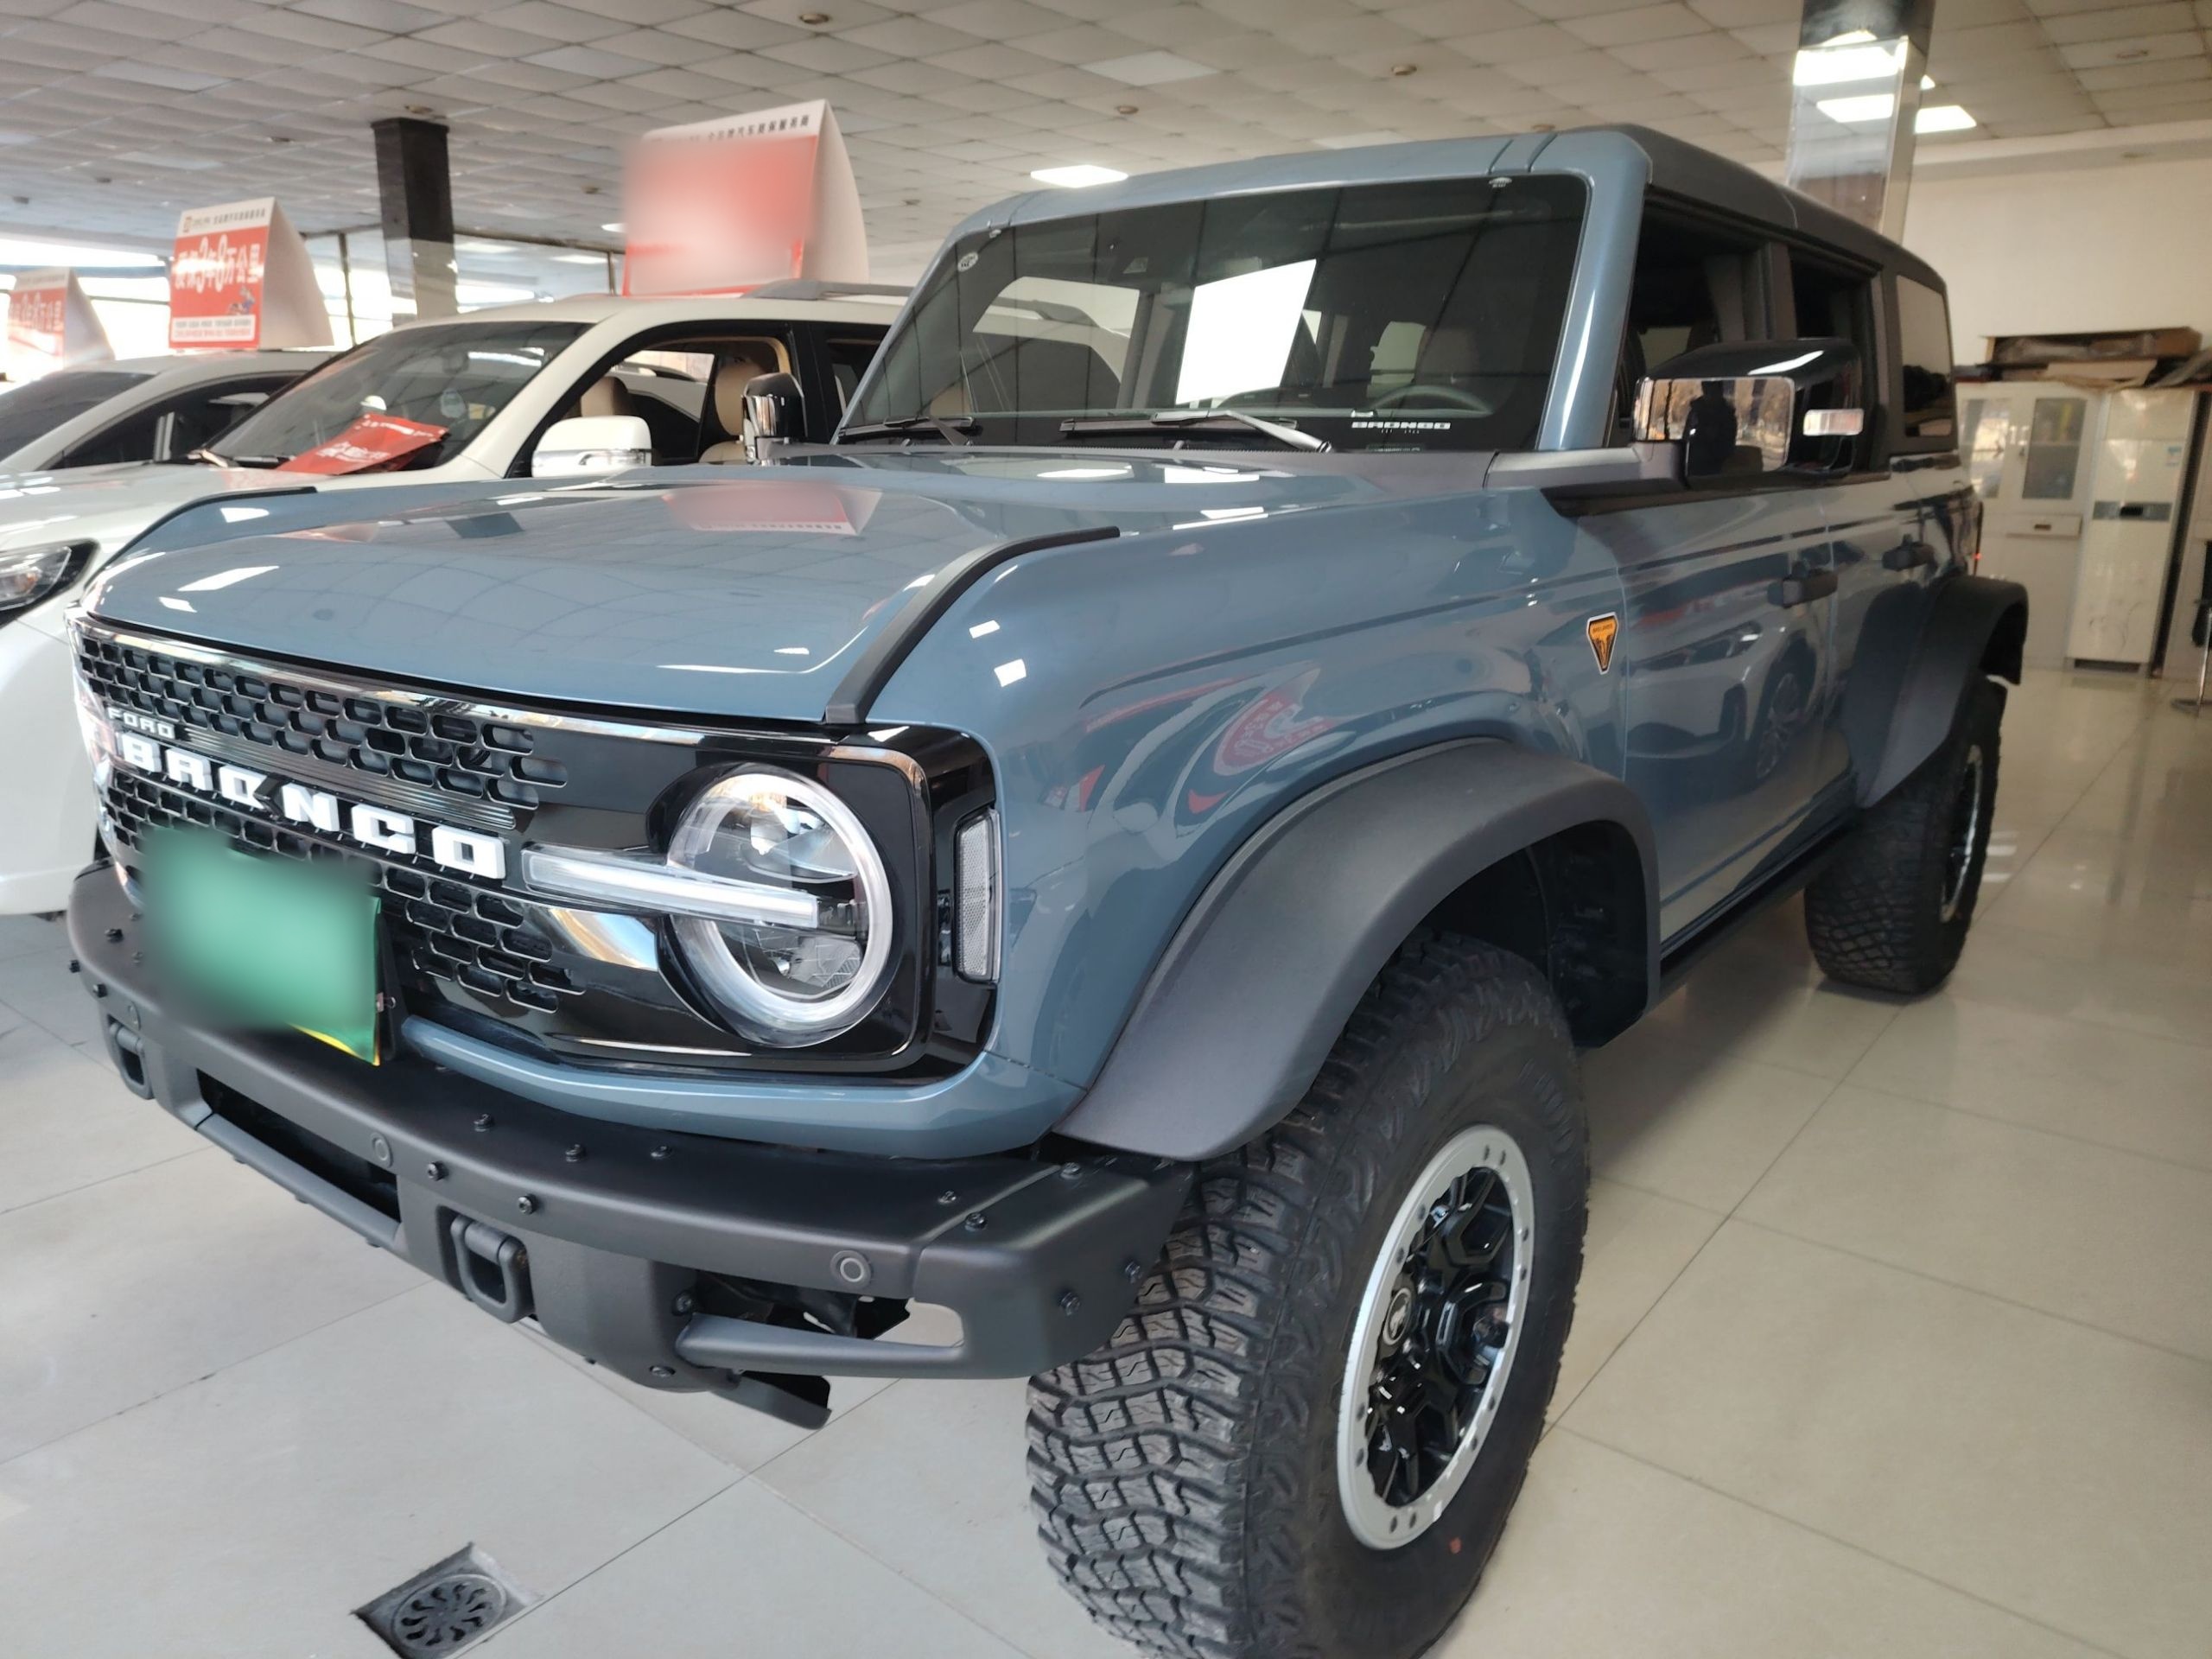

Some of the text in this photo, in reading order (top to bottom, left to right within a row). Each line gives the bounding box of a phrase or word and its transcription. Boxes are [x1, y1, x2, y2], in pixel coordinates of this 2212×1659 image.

[1351, 422, 1451, 430] BRONCO
[108, 708, 175, 740] FORD
[121, 731, 506, 880] BRONCO
